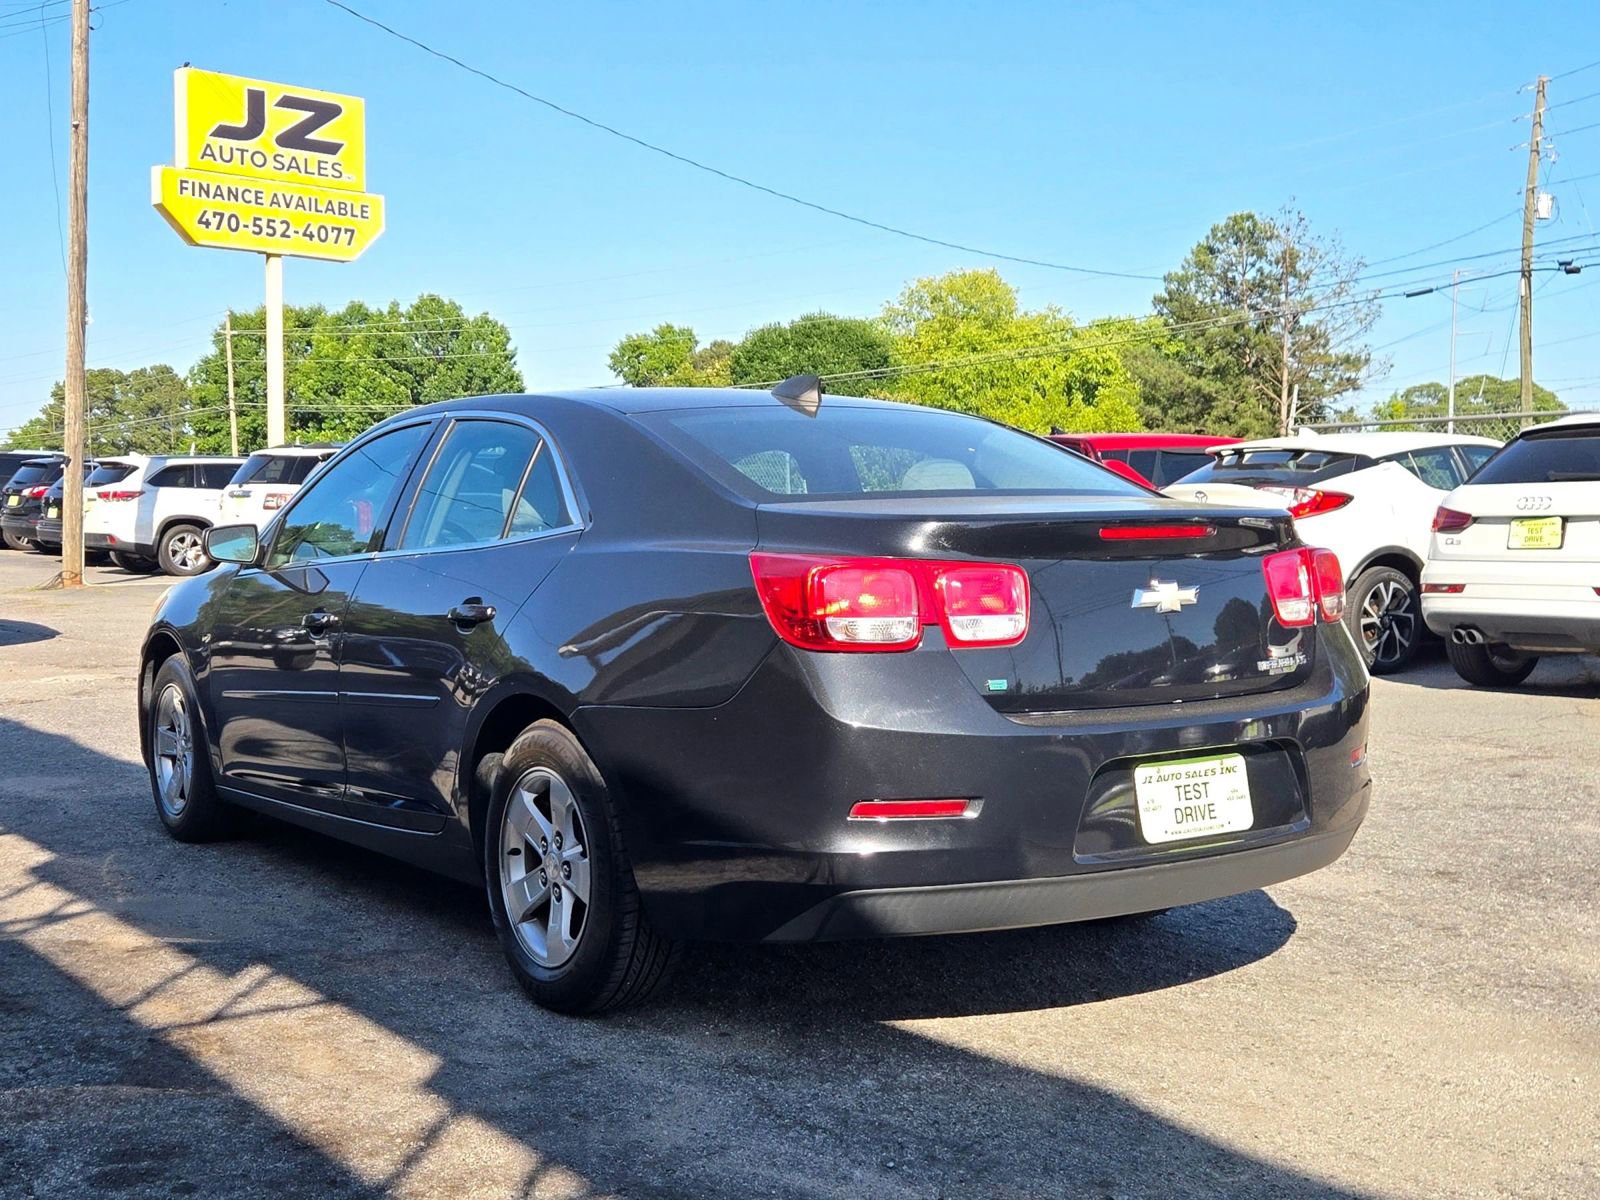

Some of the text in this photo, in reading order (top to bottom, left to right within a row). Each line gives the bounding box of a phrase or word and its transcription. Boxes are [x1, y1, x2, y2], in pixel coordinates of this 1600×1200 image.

[208, 87, 345, 156] JZ
[200, 143, 343, 179] AUTO SALES
[179, 179, 369, 220] FINANCE AVAILABLE
[197, 210, 356, 246] 470-552-4077
[1524, 535, 1544, 543] DRIVE
[1527, 527, 1543, 535] TEST
[1142, 765, 1238, 785] JZ AUTO SALES INC
[1174, 781, 1210, 802] TEST
[1174, 803, 1217, 825] DRIVE
